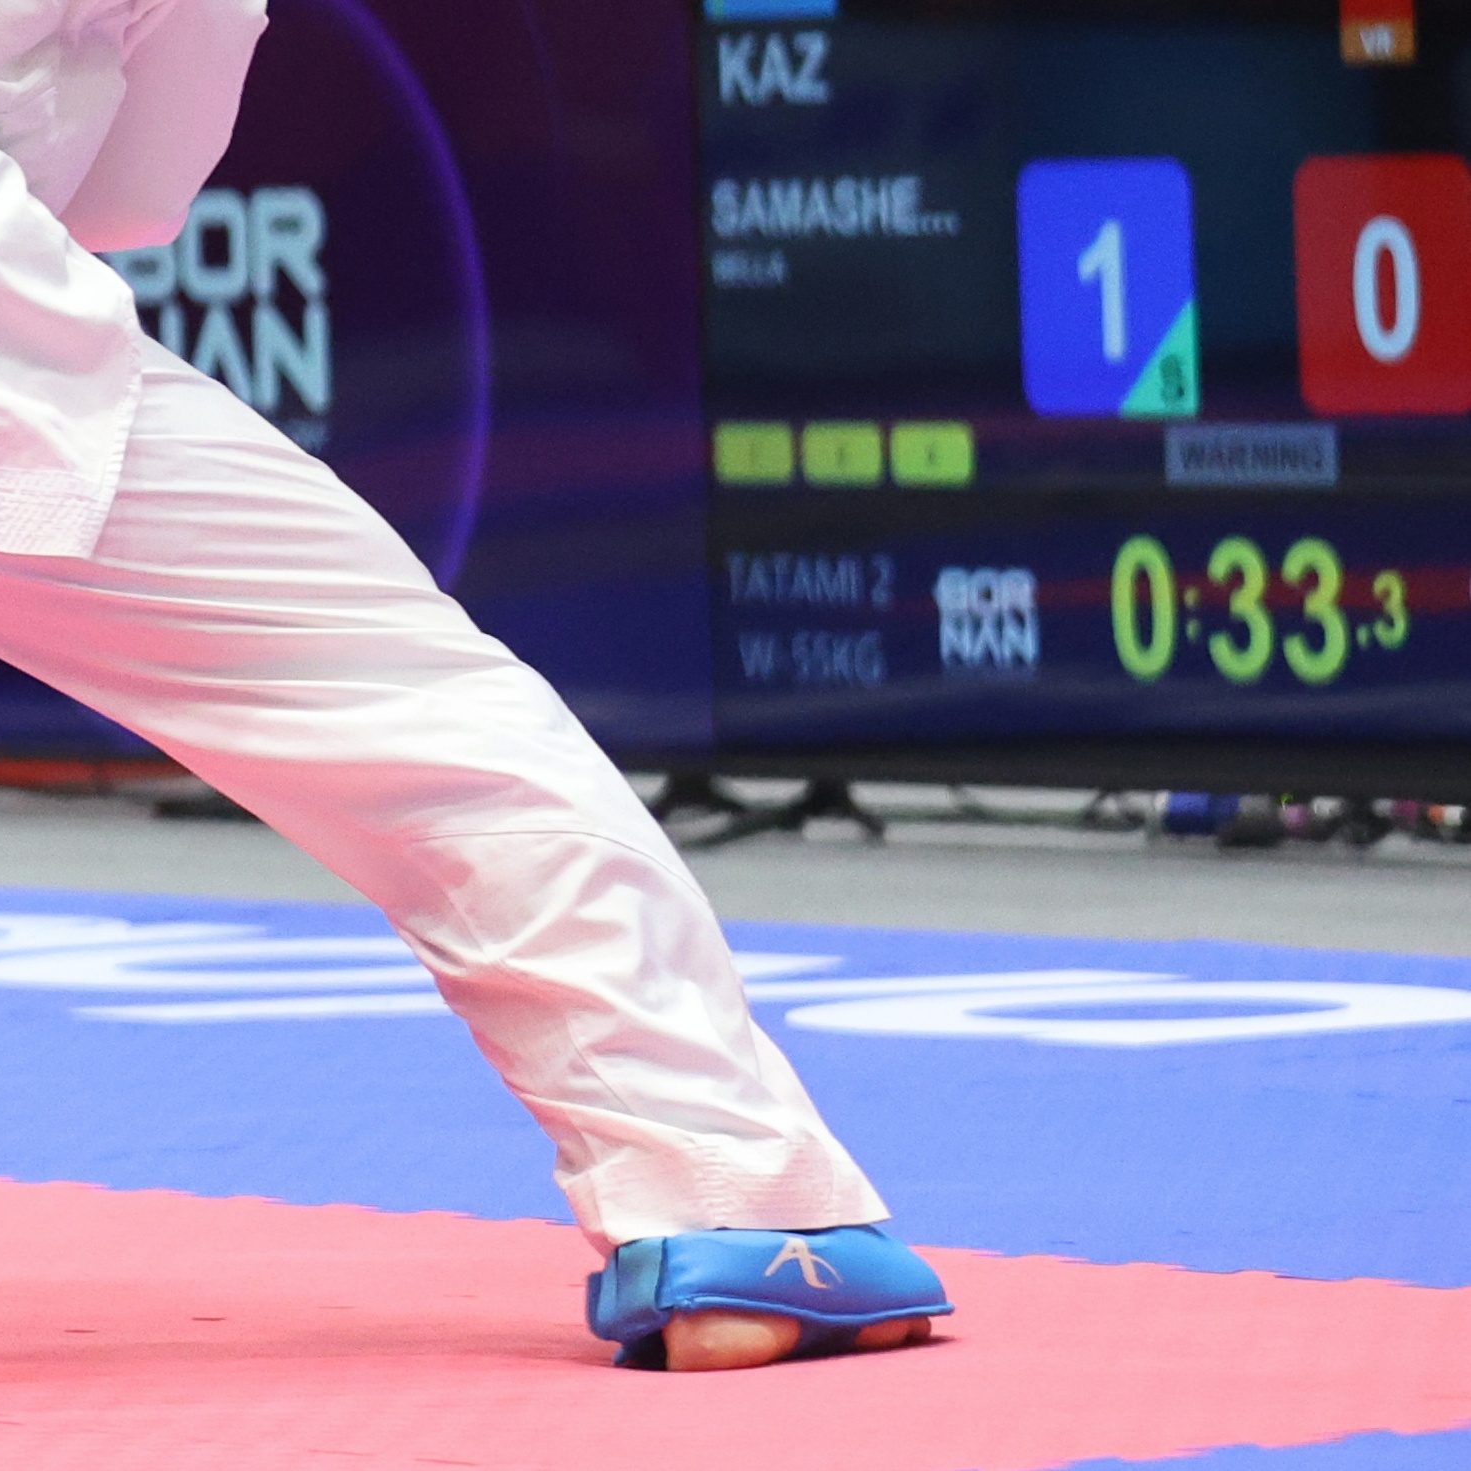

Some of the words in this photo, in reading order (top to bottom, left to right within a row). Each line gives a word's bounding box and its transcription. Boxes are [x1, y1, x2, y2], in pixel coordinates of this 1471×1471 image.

[718, 30, 832, 106] KAZ
[1077, 218, 1127, 364] 1
[1352, 213, 1421, 364] 0
[157, 298, 331, 412] AN
[726, 551, 861, 605] TATAMI
[871, 552, 895, 609] 2
